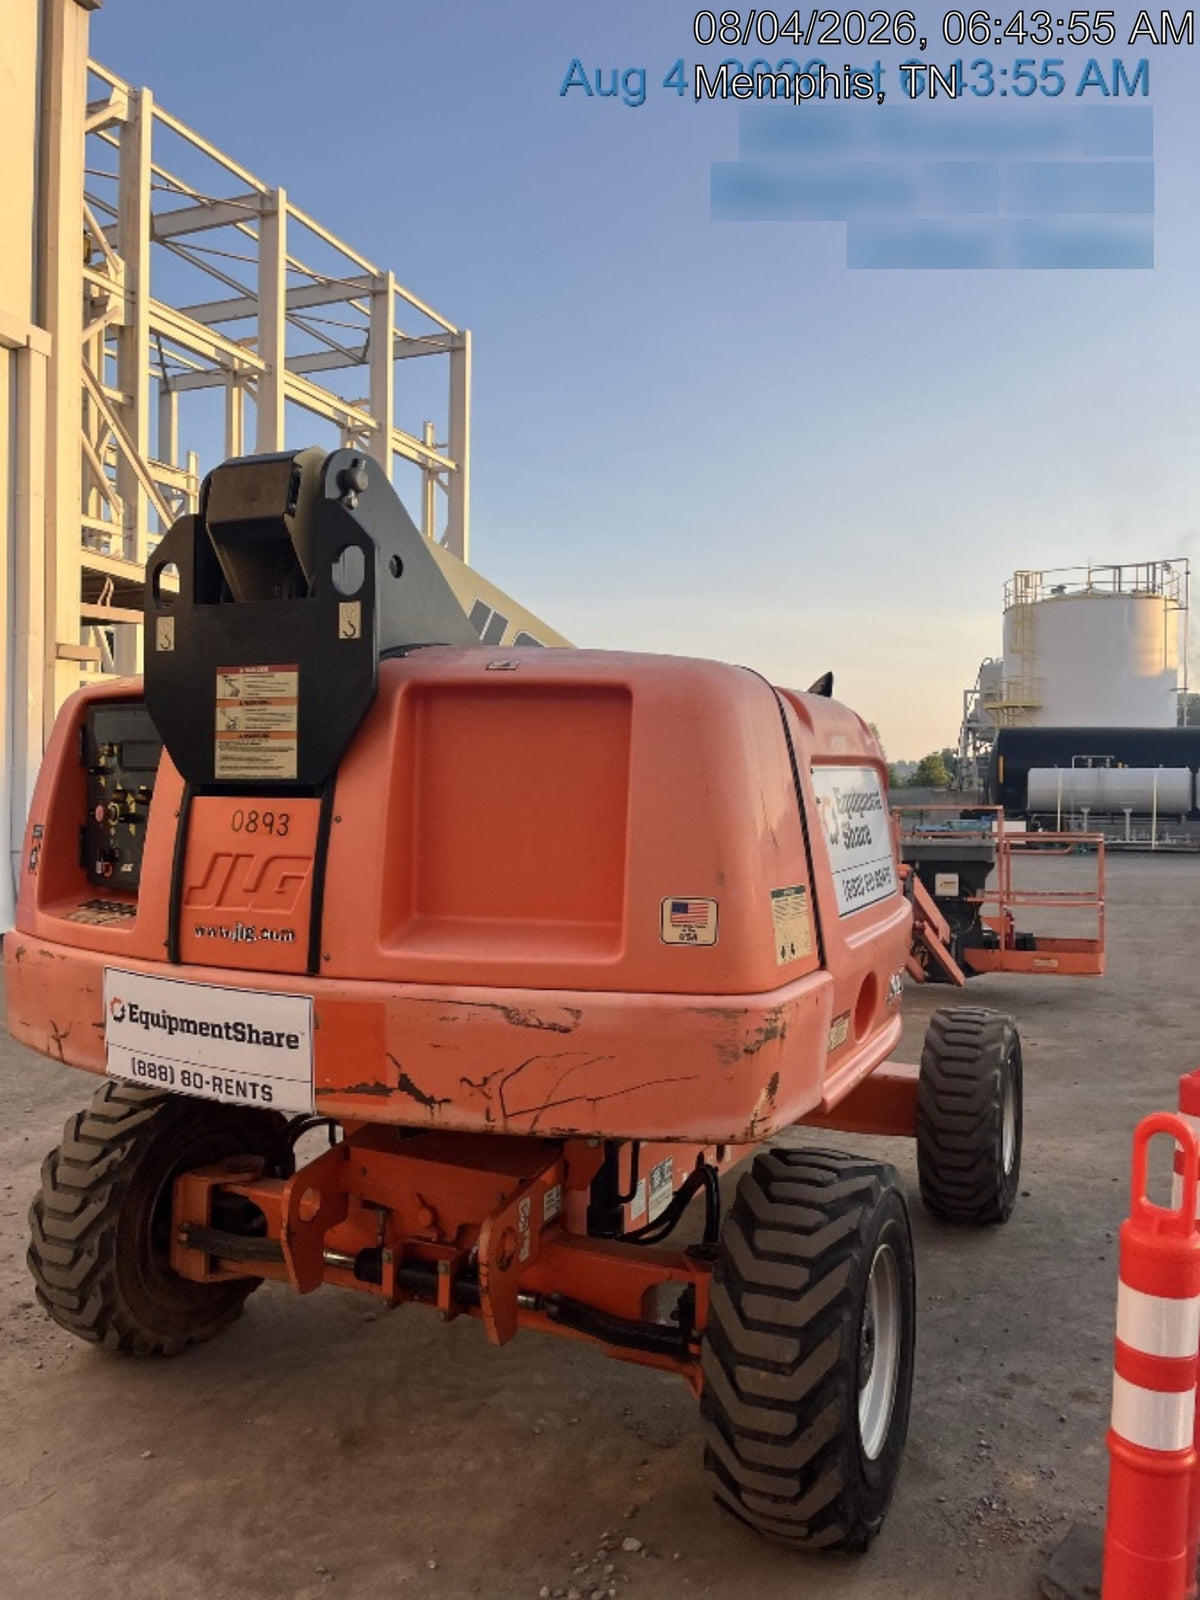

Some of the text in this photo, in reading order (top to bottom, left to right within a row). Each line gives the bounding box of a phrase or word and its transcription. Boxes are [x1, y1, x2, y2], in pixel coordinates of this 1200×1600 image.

[231, 809, 290, 837] 0893
[183, 853, 313, 914] JLG
[127, 1002, 300, 1050] EquipmentShare
[131, 1057, 273, 1102] (888) 80-RENTS
